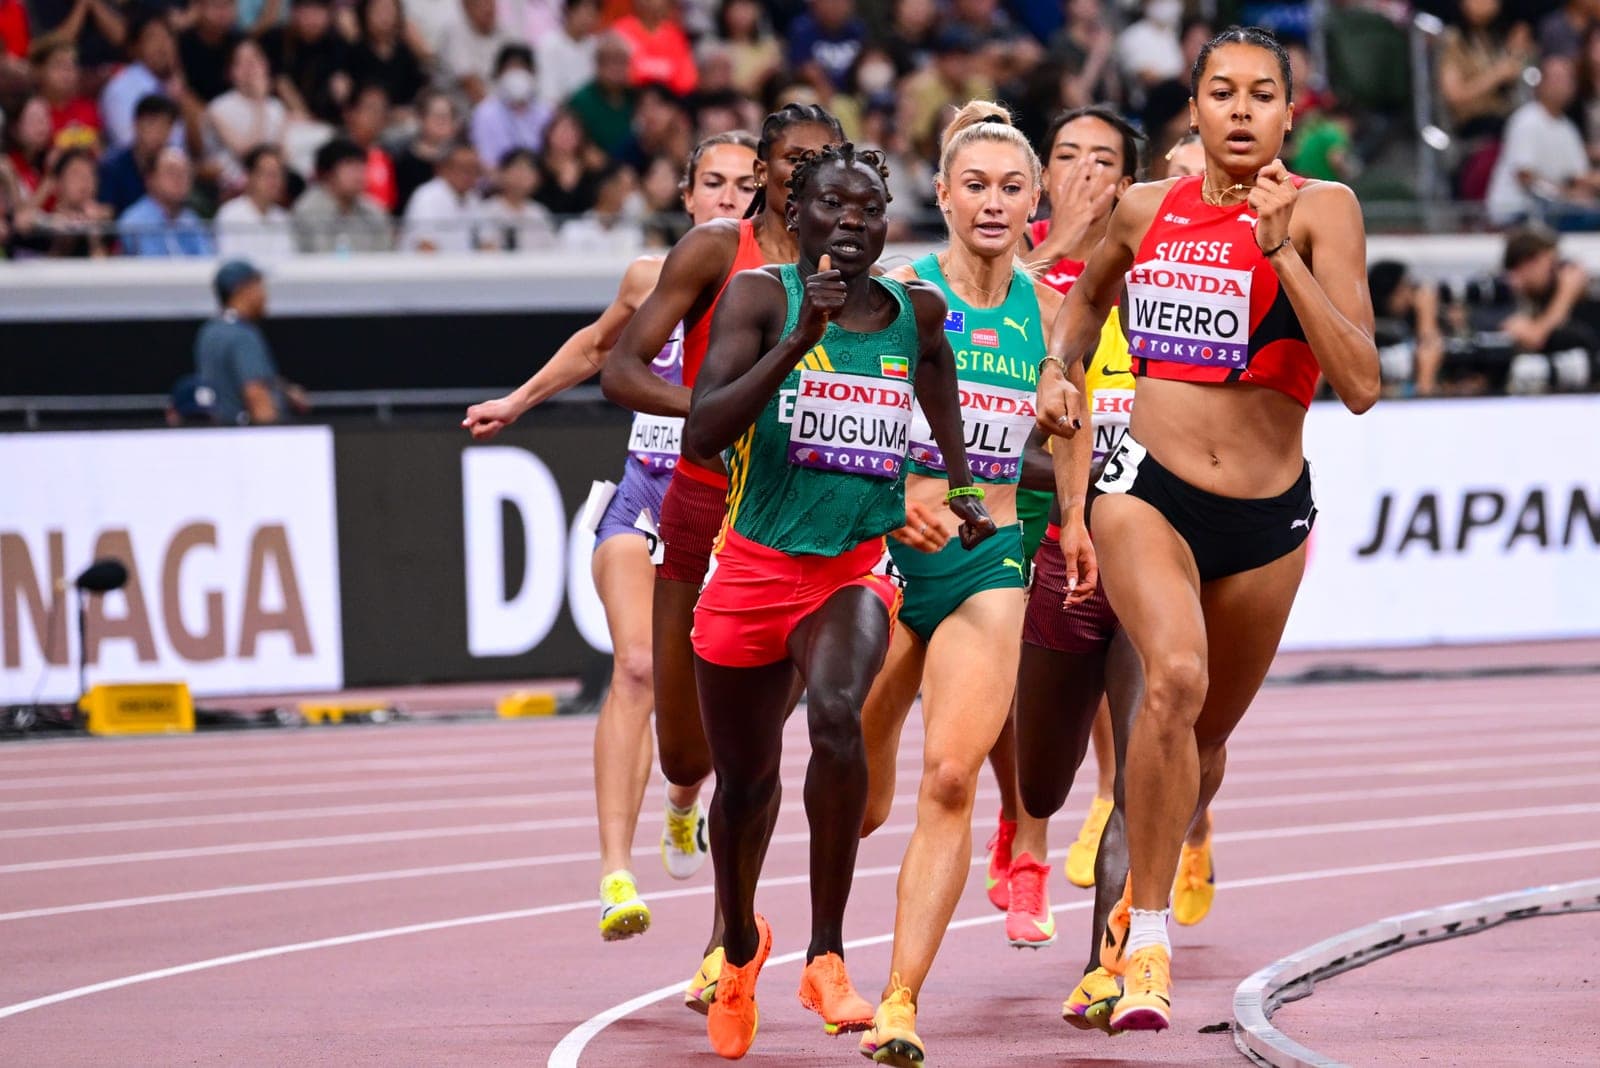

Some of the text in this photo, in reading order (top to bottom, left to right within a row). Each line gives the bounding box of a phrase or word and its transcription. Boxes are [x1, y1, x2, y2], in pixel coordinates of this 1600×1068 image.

[1129, 268, 1246, 298] HONDA
[1135, 298, 1239, 339] WERRO
[956, 350, 1037, 387] STRALIA
[1217, 349, 1241, 361] 25
[801, 380, 912, 412] HONDA
[799, 411, 907, 451] DUGUMA
[962, 421, 1012, 453] ULL
[1102, 445, 1129, 483] 5
[1358, 490, 1600, 556] JAPAN
[0, 521, 315, 668] NAGA
